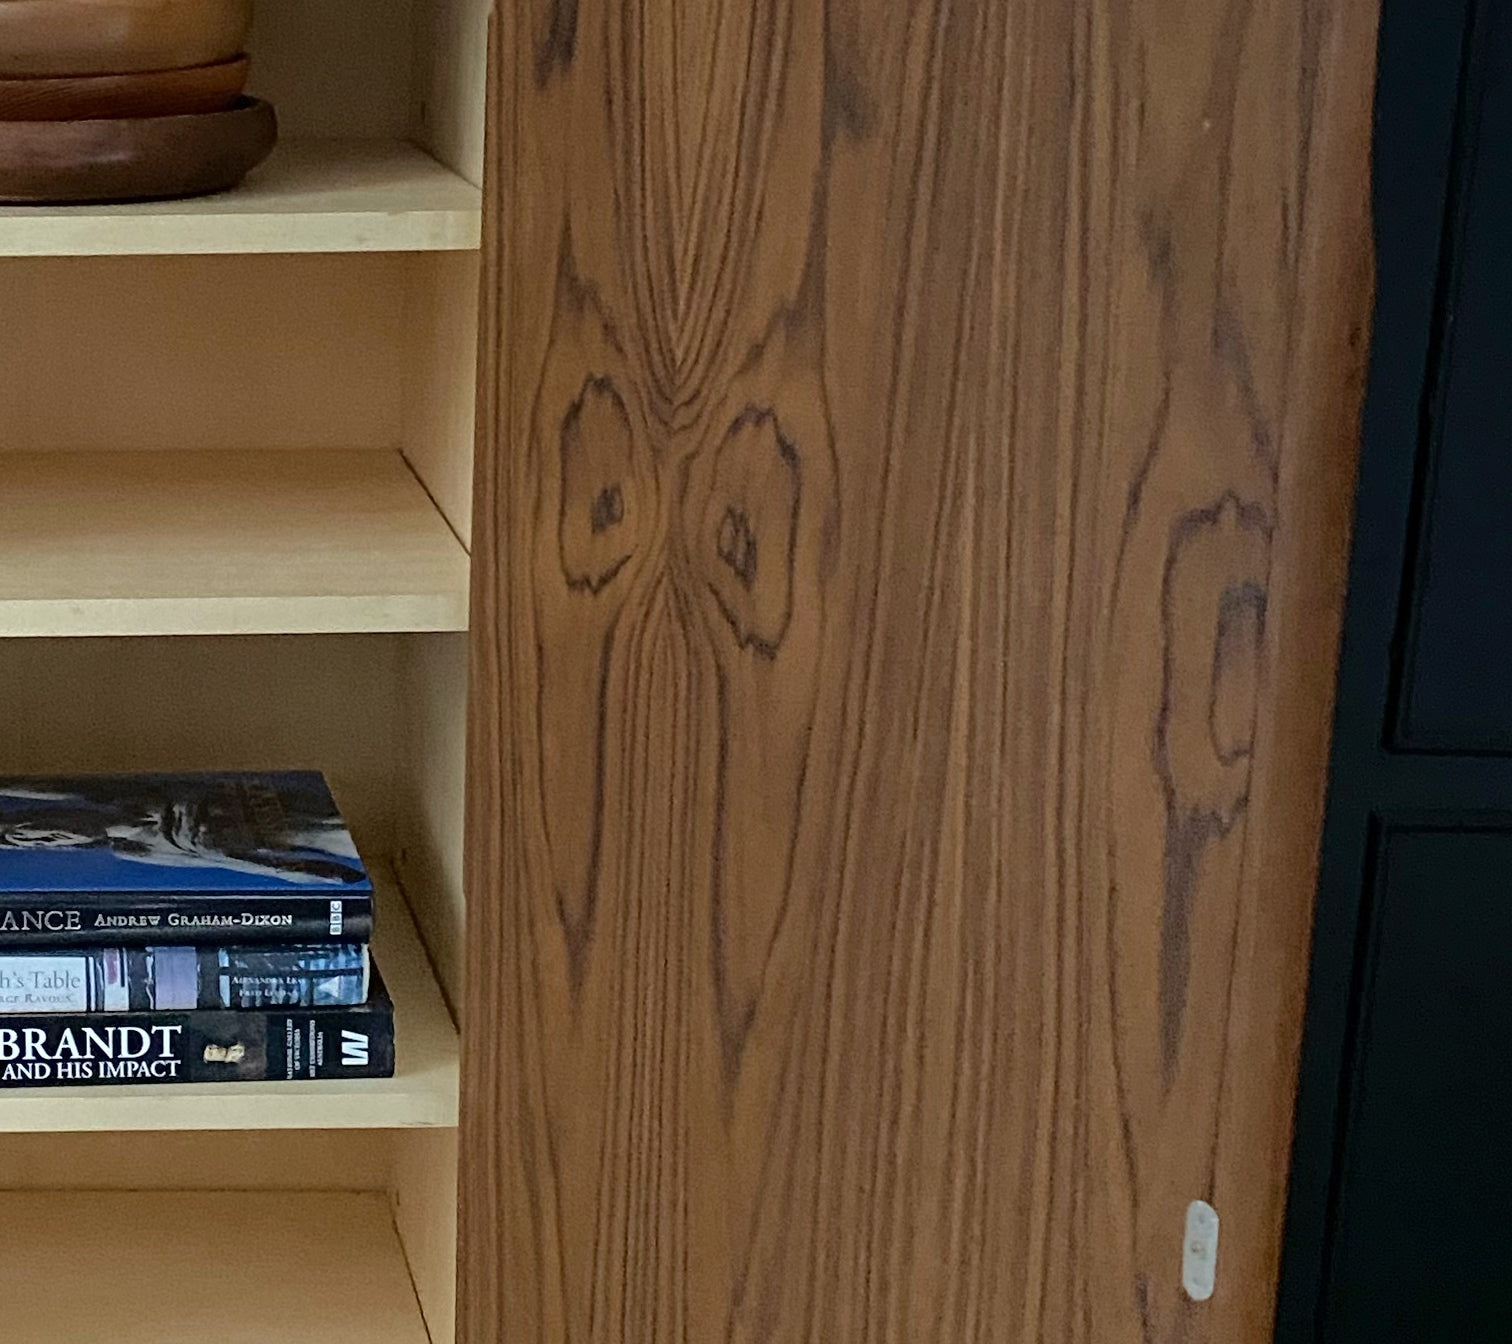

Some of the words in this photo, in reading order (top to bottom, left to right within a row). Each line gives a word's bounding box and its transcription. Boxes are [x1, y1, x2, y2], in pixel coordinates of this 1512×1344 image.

[94, 913, 161, 927] ANDREW
[167, 912, 293, 927] GRAHAM-DIXON
[29, 969, 81, 989] Table
[2, 1062, 51, 1080] AND
[57, 1061, 93, 1079] HIS
[99, 1059, 181, 1078] IMPACT
